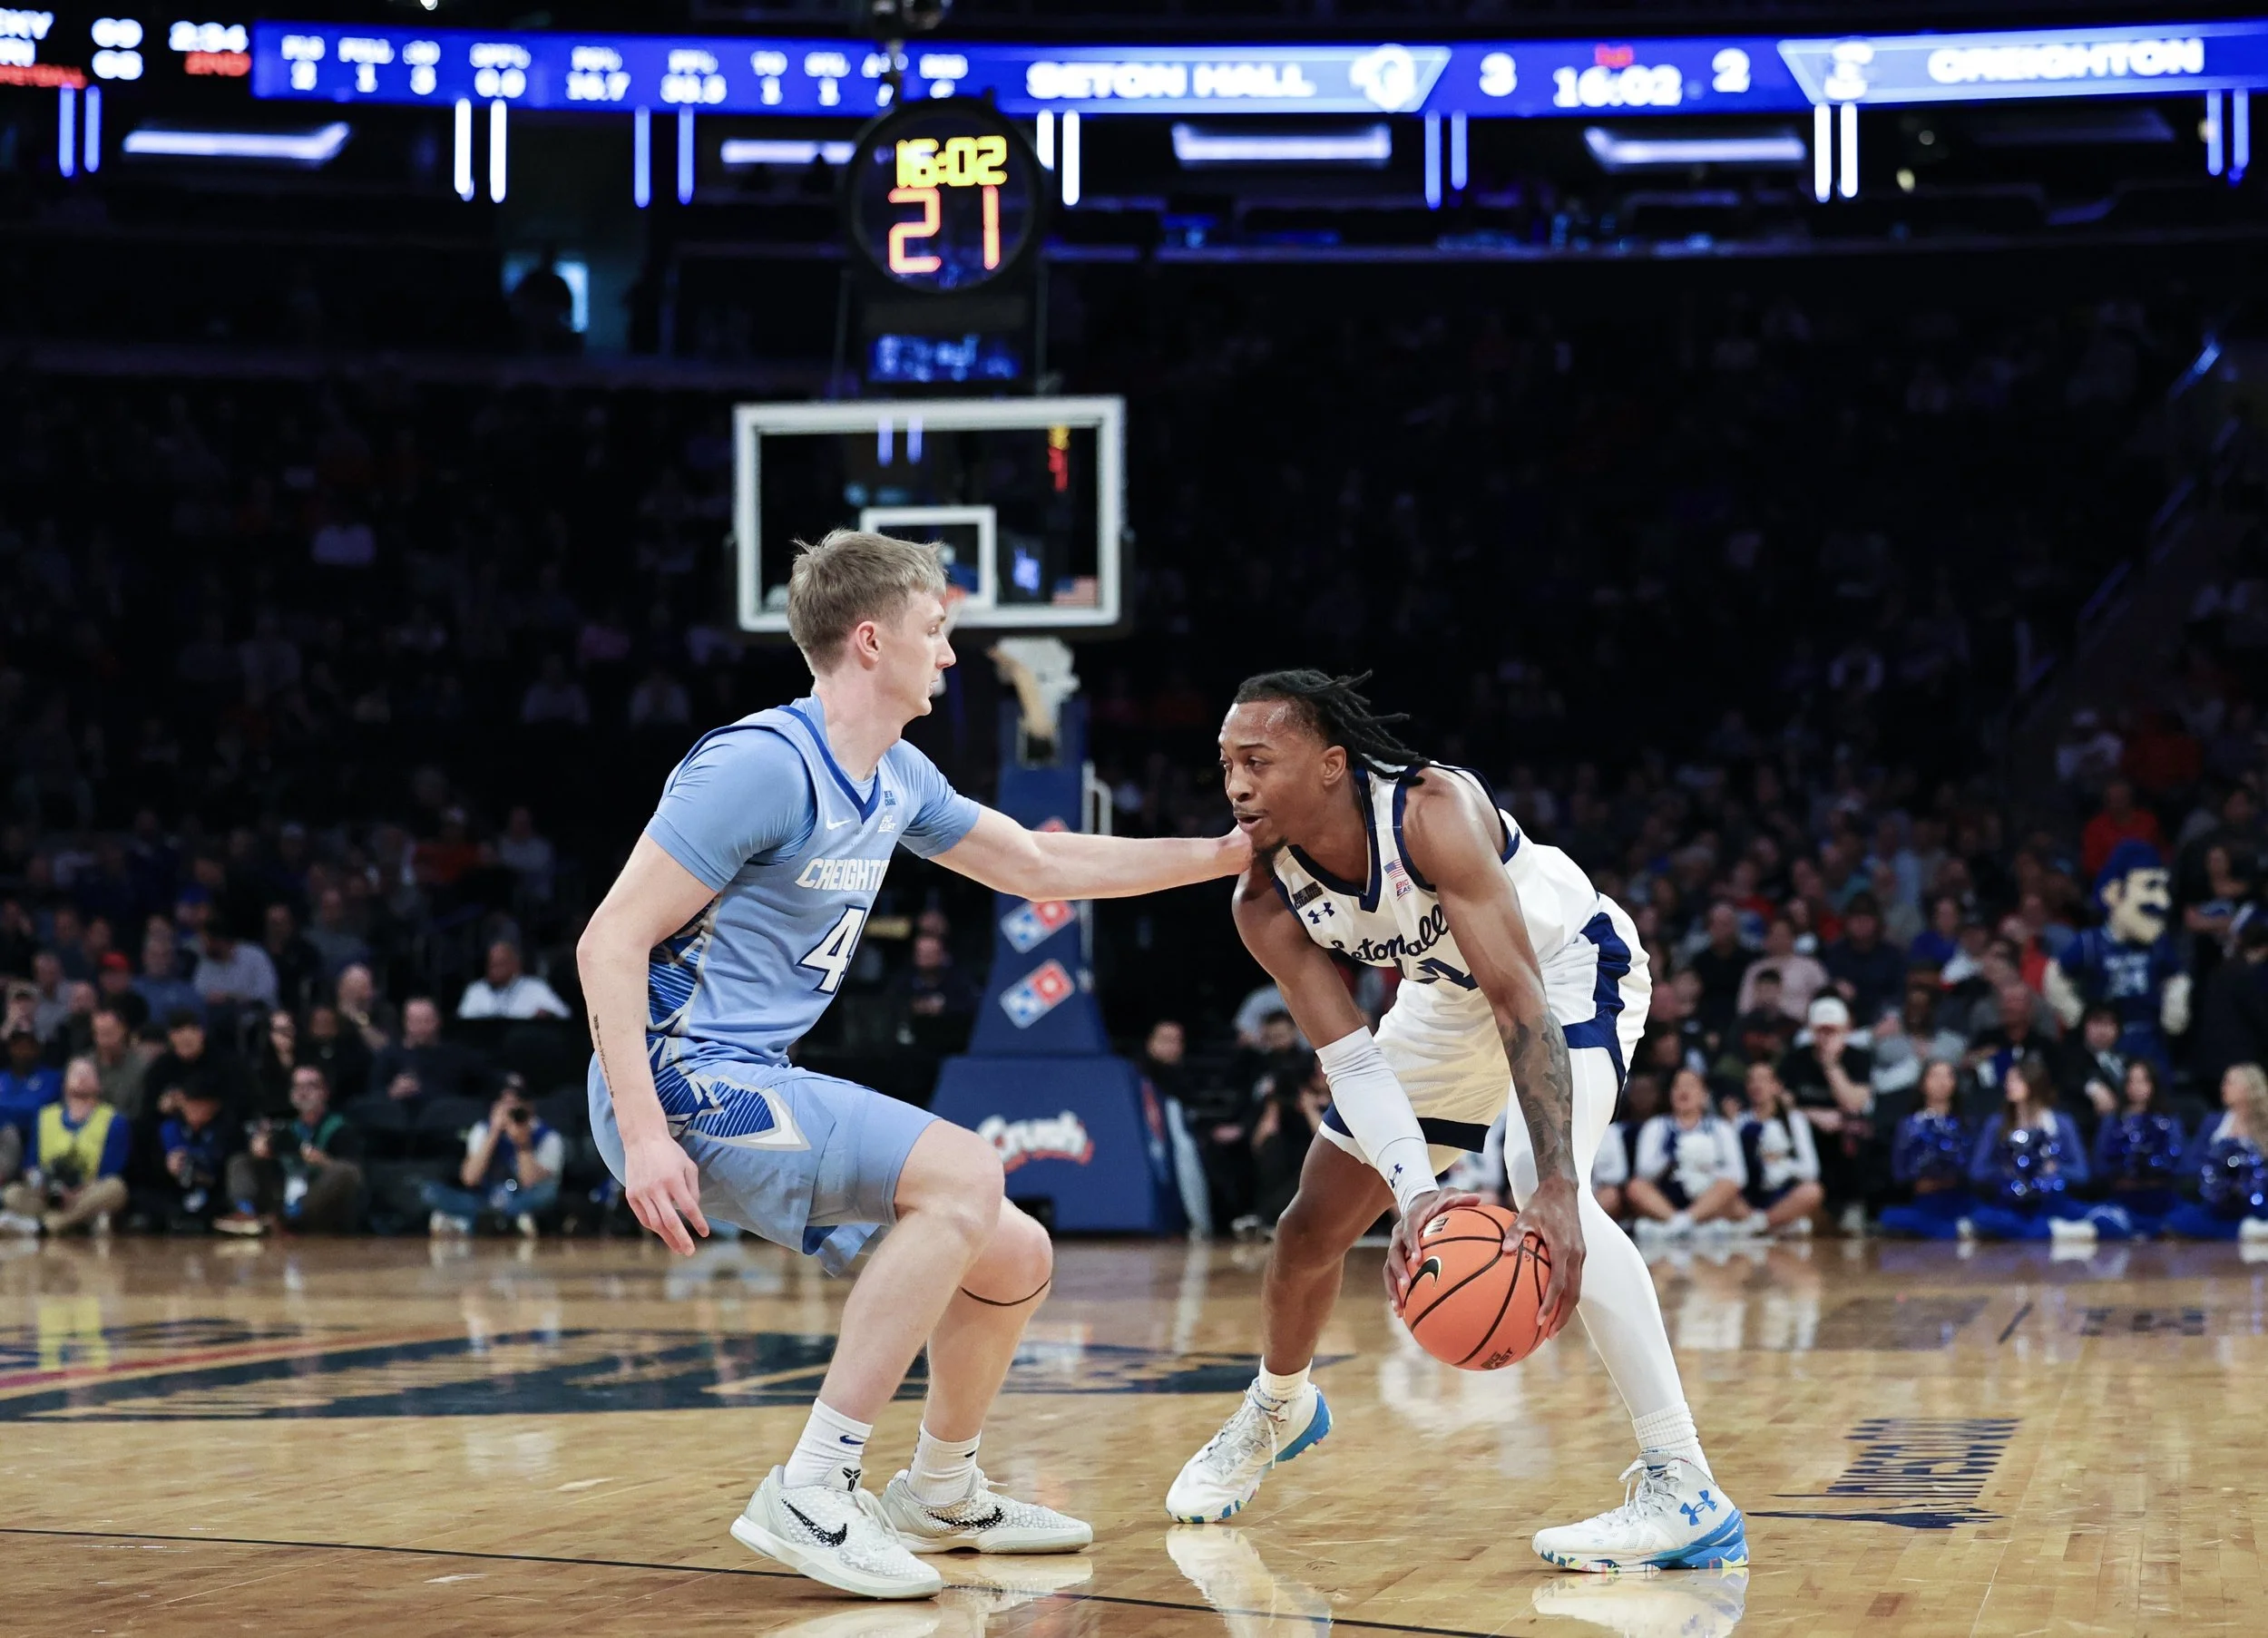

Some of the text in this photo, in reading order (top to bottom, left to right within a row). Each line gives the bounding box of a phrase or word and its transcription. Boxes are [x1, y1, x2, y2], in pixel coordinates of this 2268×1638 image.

[1027, 62, 1316, 99] SETON HALL
[1480, 53, 1518, 96] 3
[1712, 48, 1751, 93] 2
[1928, 38, 2204, 83] CREIGHTON
[1553, 64, 1683, 107] 16:02
[896, 135, 1007, 188] 16:02
[888, 184, 1001, 273] 21
[1395, 879, 1409, 890] BIG
[1397, 885, 1414, 897] EAS
[796, 904, 868, 995] 4
[1405, 903, 1450, 957] all
[1767, 1443, 2007, 1498] Invesco
